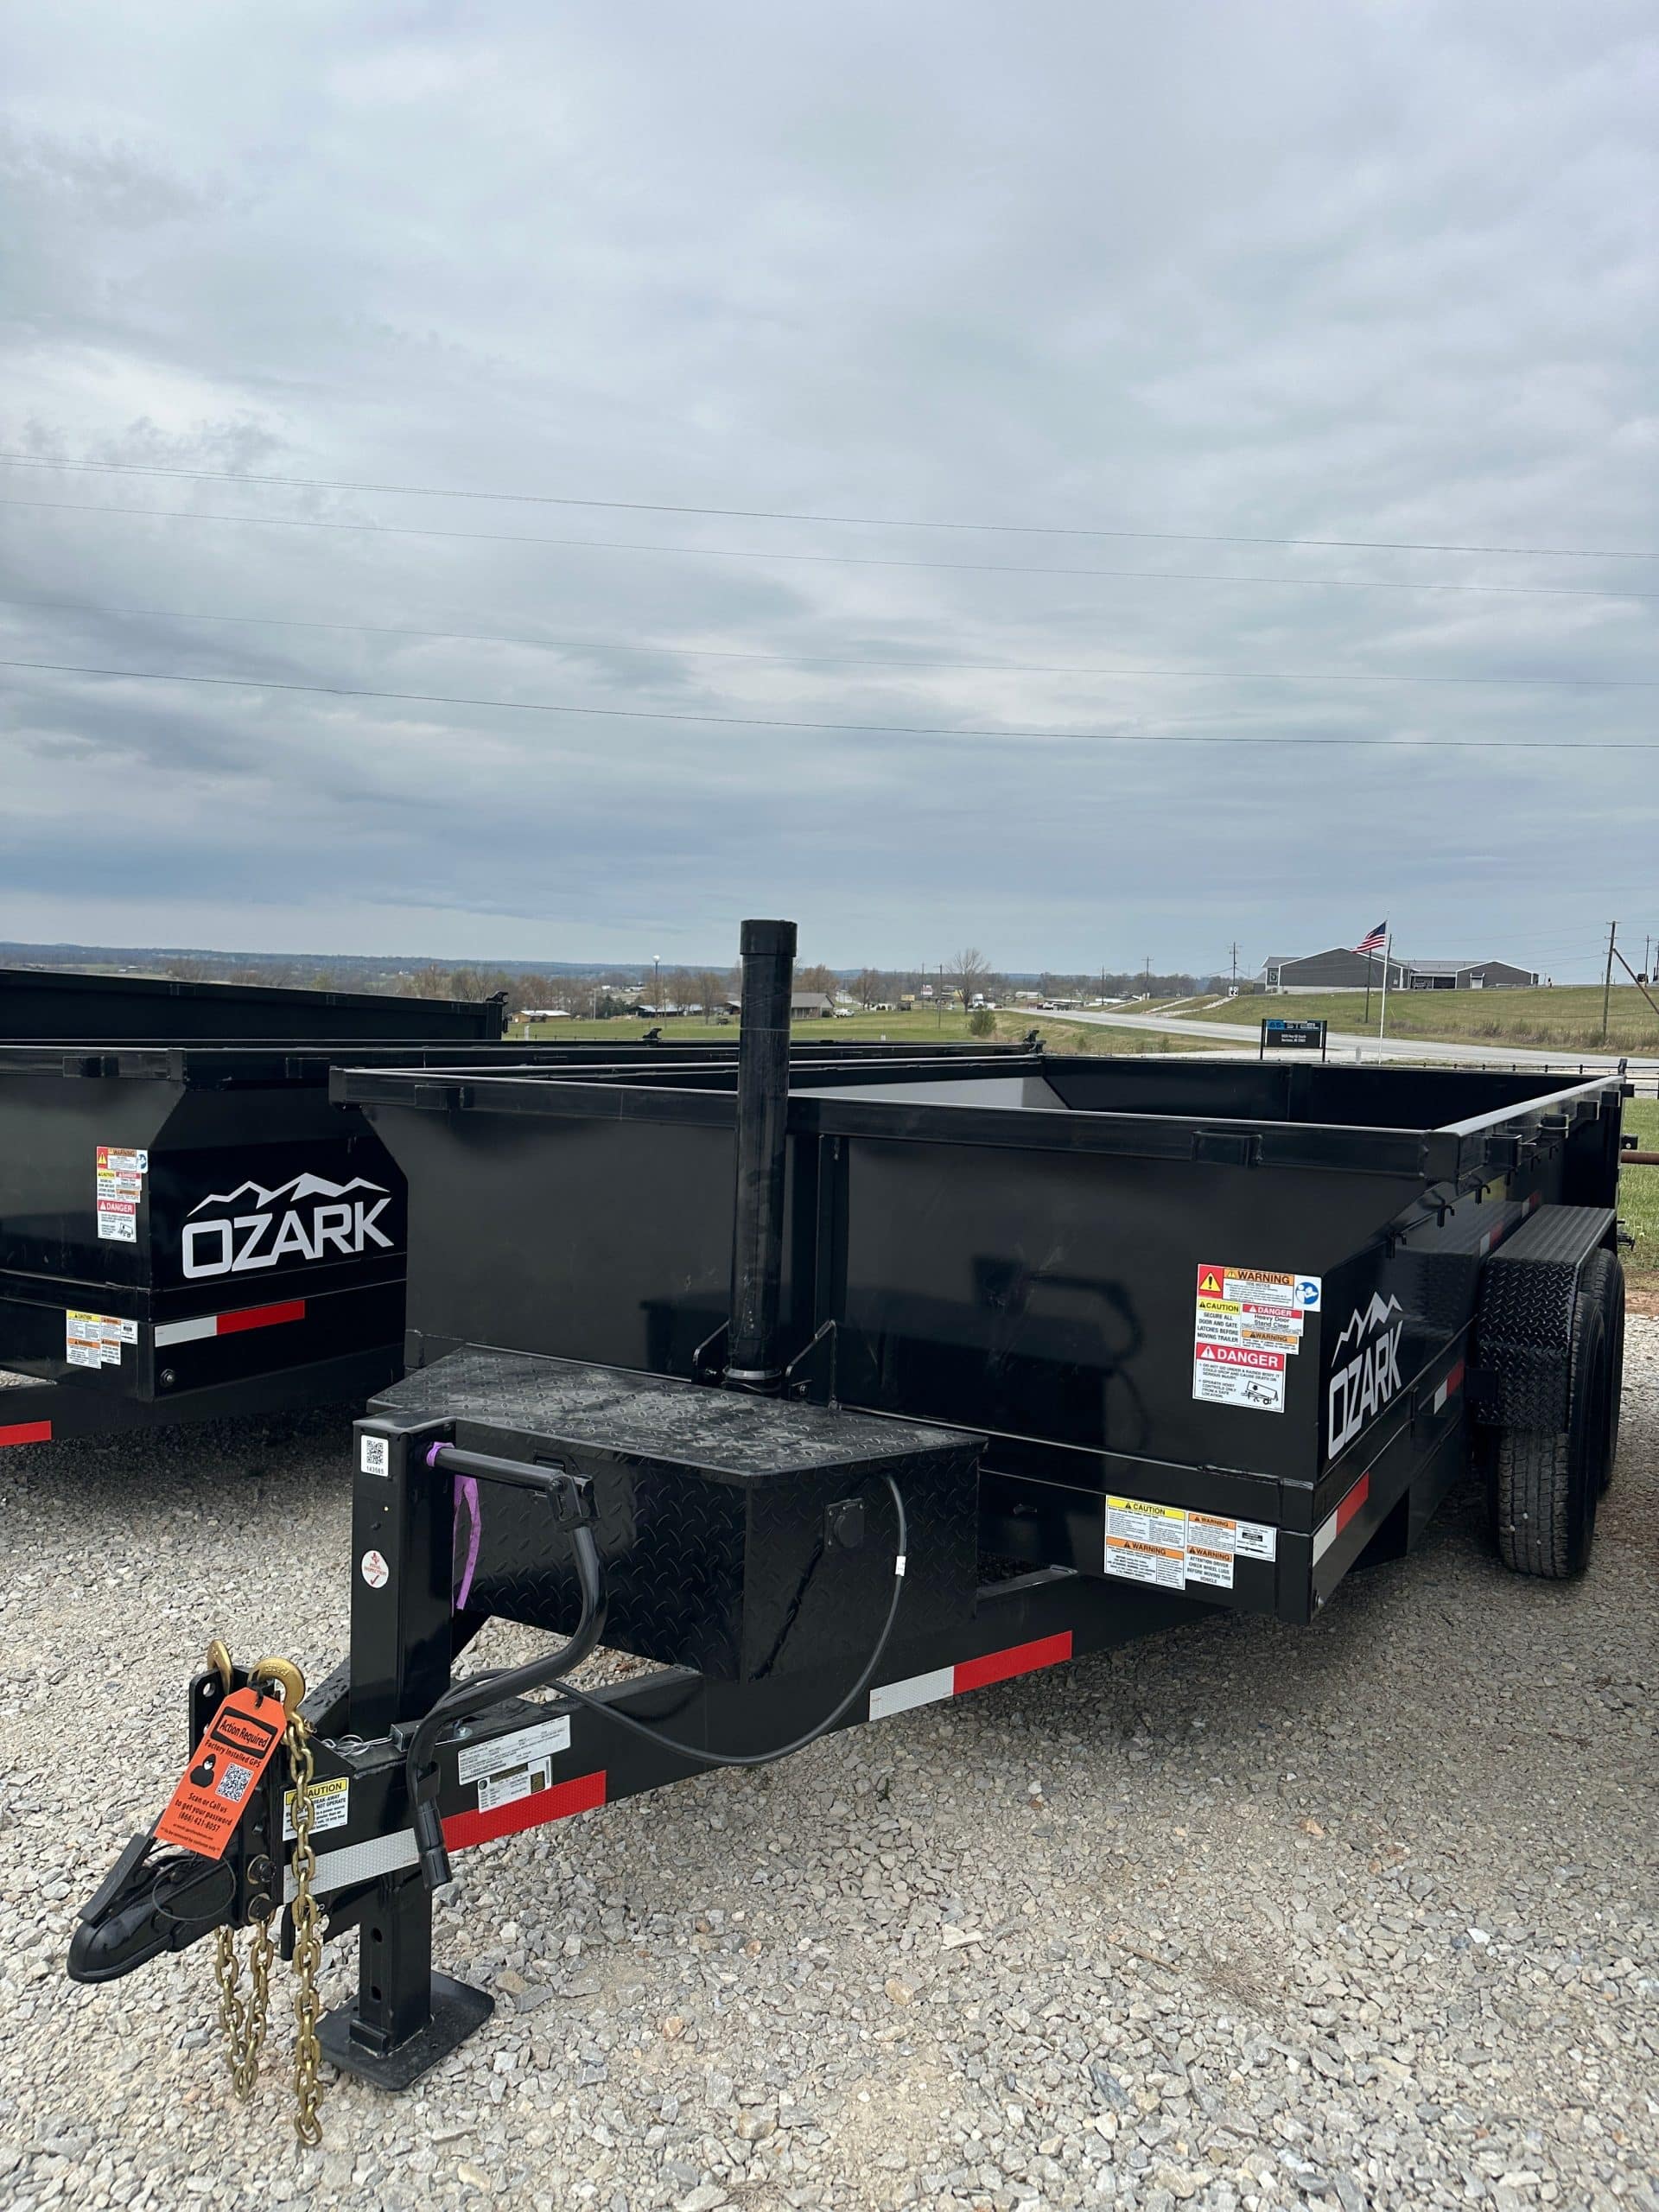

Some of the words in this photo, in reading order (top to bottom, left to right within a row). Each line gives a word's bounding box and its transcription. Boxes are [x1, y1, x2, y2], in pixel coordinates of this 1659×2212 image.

[107, 1203, 132, 1213] DANGER
[182, 1198, 394, 1279] OZARK
[1237, 1270, 1290, 1285] WARNING
[1206, 1302, 1239, 1312] CAUTION
[1258, 1306, 1293, 1317] DANGER
[1217, 1349, 1278, 1367] DANGER
[1329, 1320, 1402, 1460] OZARK
[1134, 1503, 1165, 1516] CAUTION
[1201, 1517, 1228, 1527] WARNING
[1132, 1542, 1166, 1555] WARNING
[1197, 1548, 1230, 1560] WARNING
[220, 1719, 240, 1737] Action
[239, 1728, 270, 1747] Required
[205, 1739, 225, 1754] Factory
[226, 1747, 250, 1763] Installed
[250, 1758, 261, 1768] GPS
[308, 1783, 342, 1796] AUTION
[188, 1793, 201, 1804] Scan
[209, 1801, 220, 1810] Call
[327, 1798, 346, 1807] OPERATE
[178, 1811, 194, 1822] (866)
[181, 1802, 193, 1811] get
[192, 1806, 206, 1815] your
[205, 1811, 232, 1826] password
